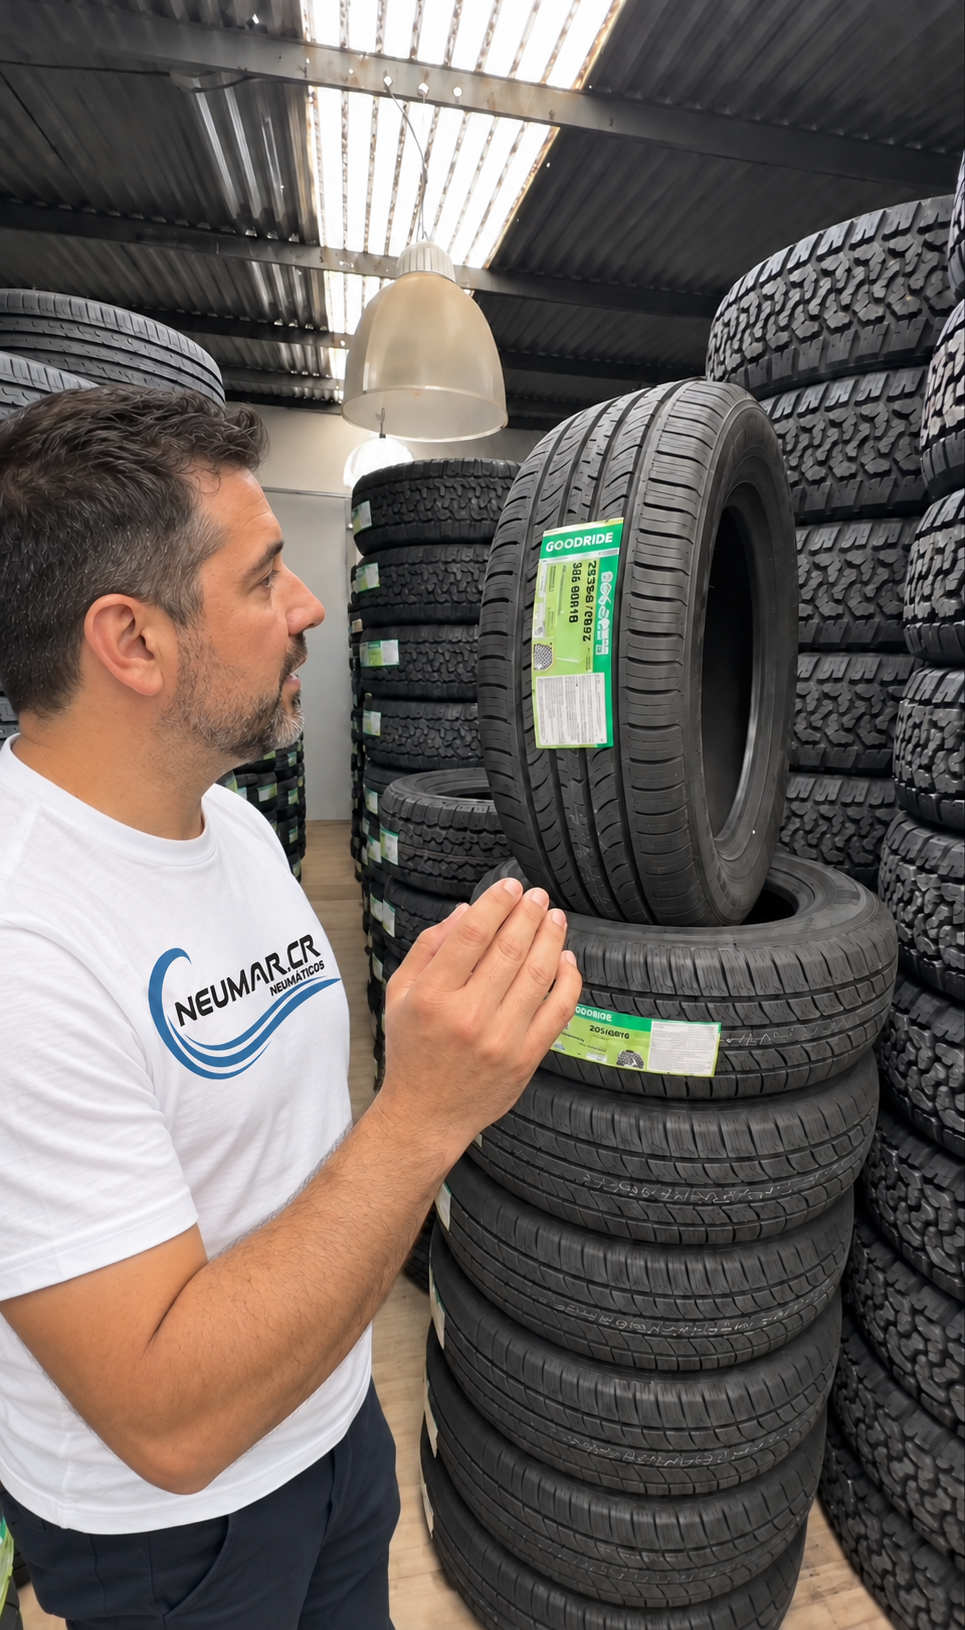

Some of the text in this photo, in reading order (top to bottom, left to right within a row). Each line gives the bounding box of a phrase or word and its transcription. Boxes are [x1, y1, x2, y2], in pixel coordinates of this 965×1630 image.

[545, 532, 613, 552] GOODRIDE
[174, 934, 321, 1027] NEUMAR.CR
[269, 960, 325, 997] NEUMÁTICOS
